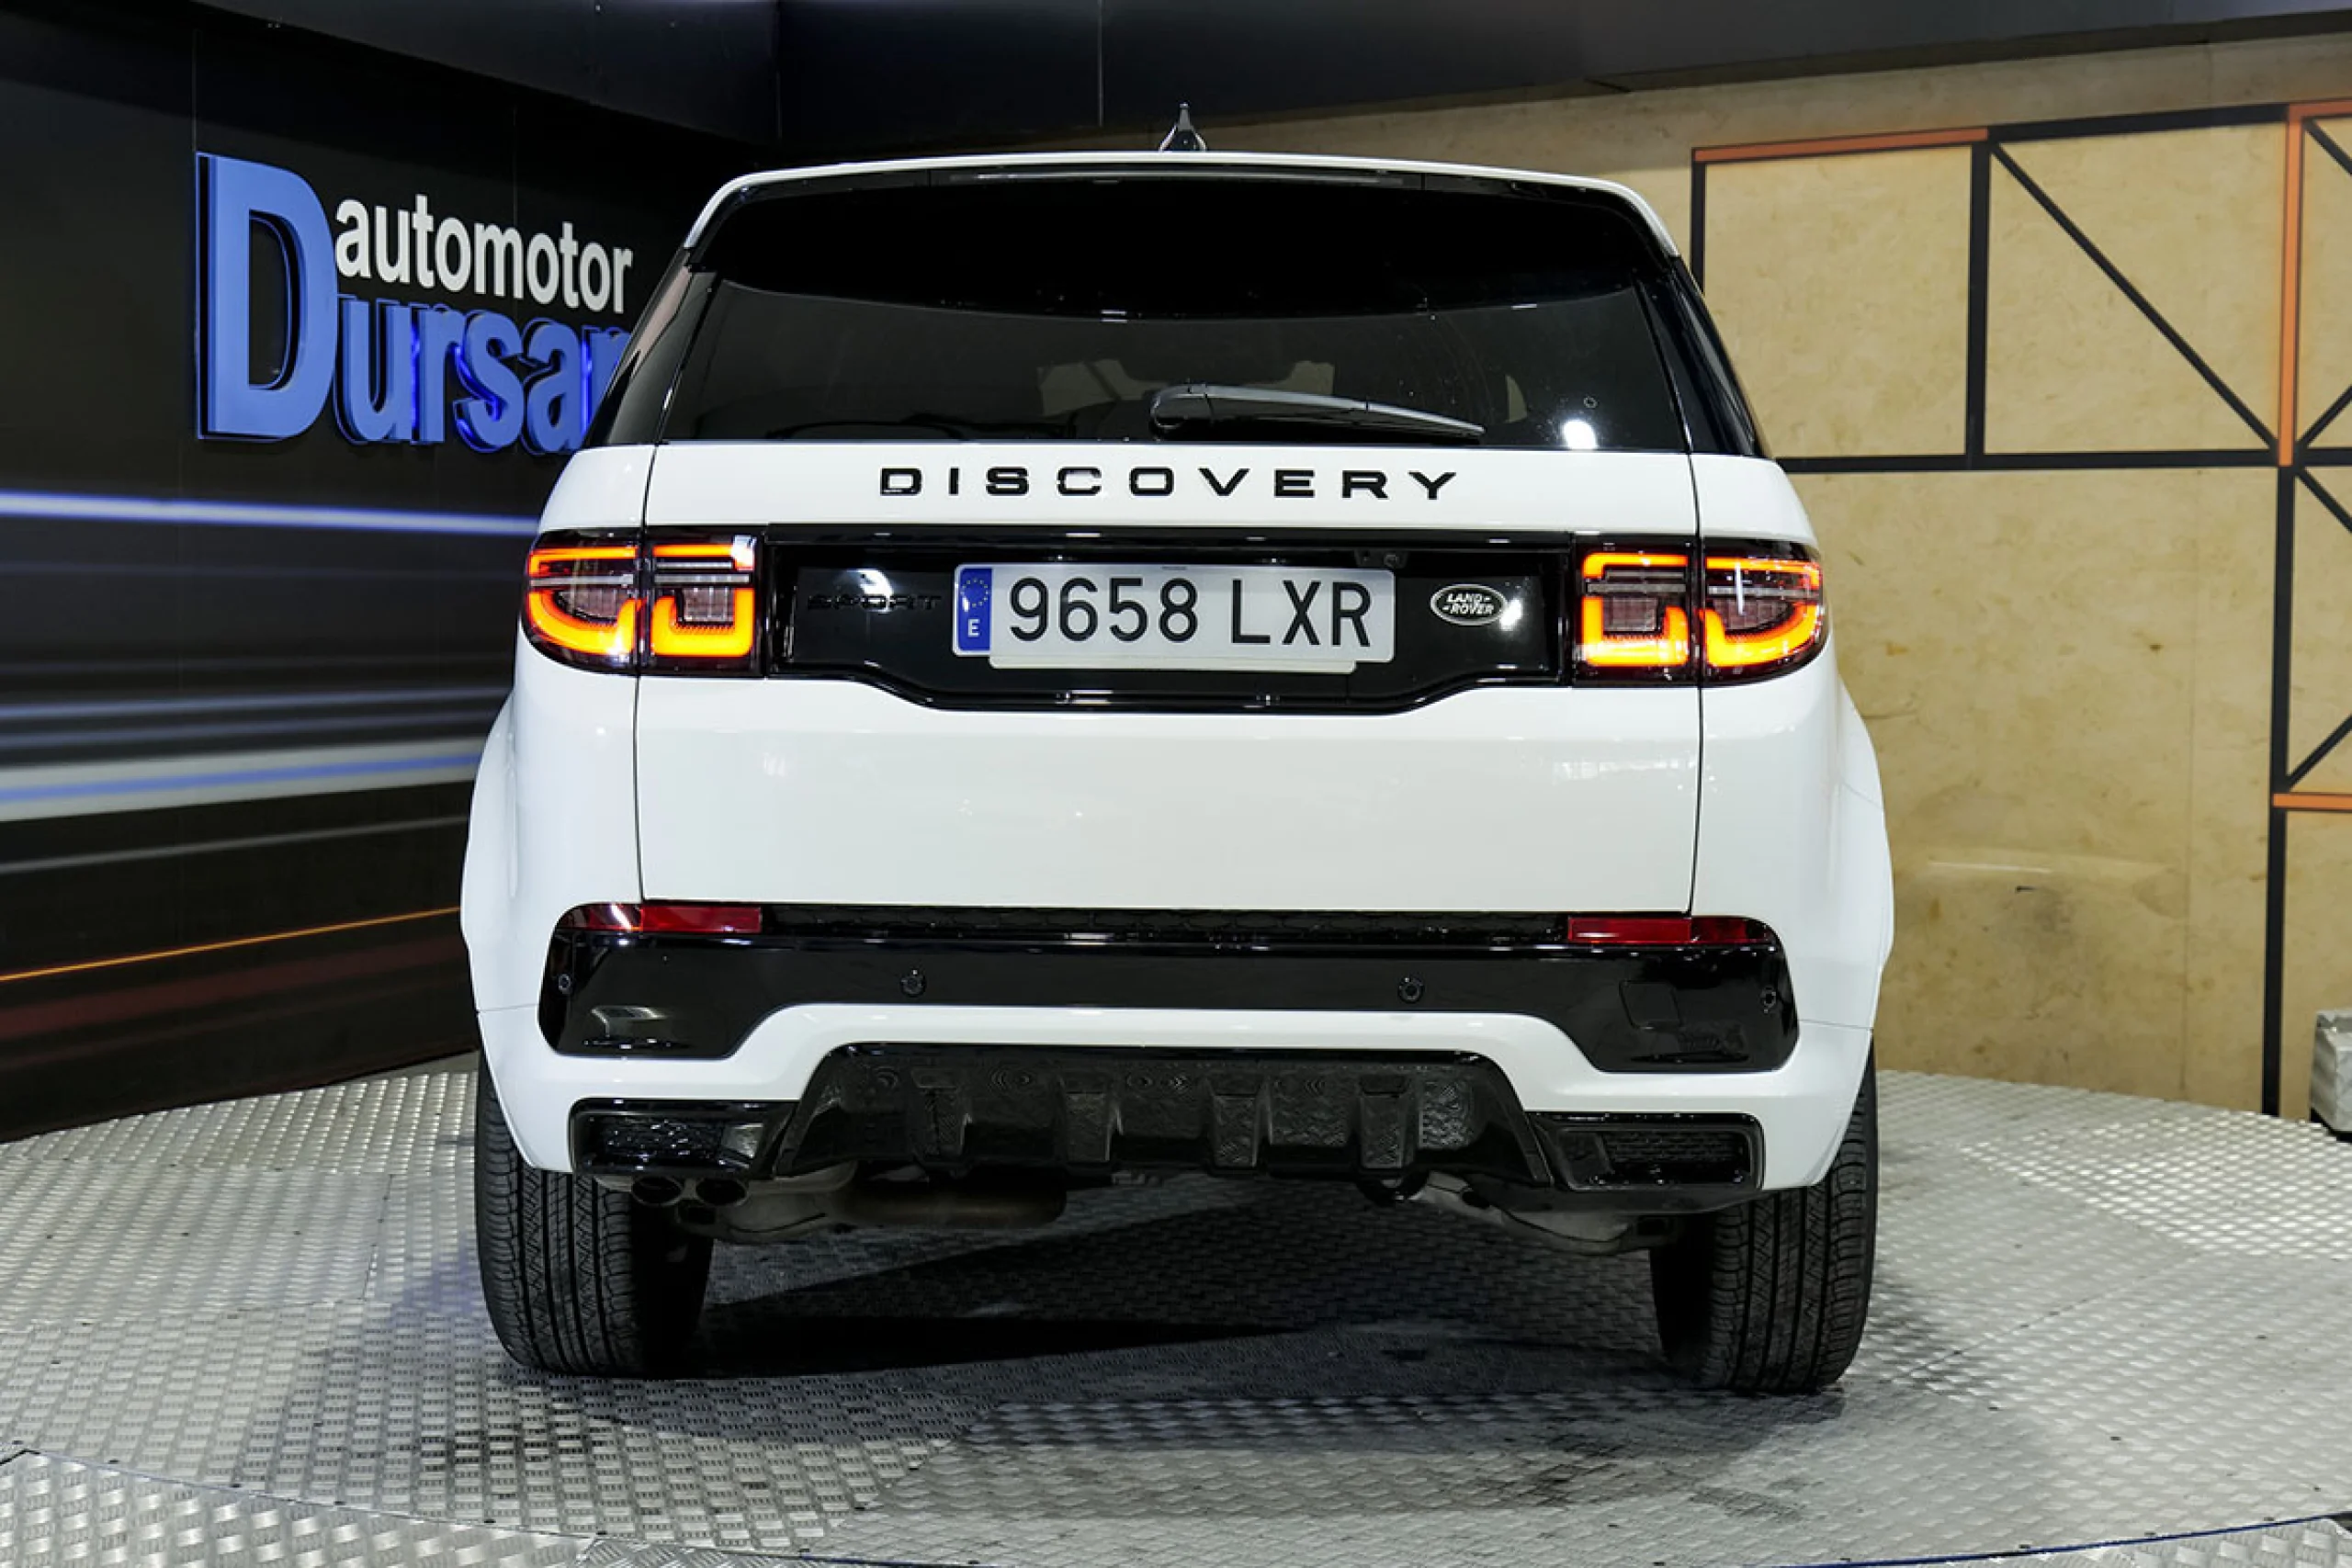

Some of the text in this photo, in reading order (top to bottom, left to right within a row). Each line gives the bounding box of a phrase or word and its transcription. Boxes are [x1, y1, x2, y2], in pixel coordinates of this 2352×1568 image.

[336, 194, 634, 314] automotor
[879, 467, 1457, 500] DISCOVERY
[967, 618, 980, 637] E
[1009, 576, 1373, 647] 9658 LXR
